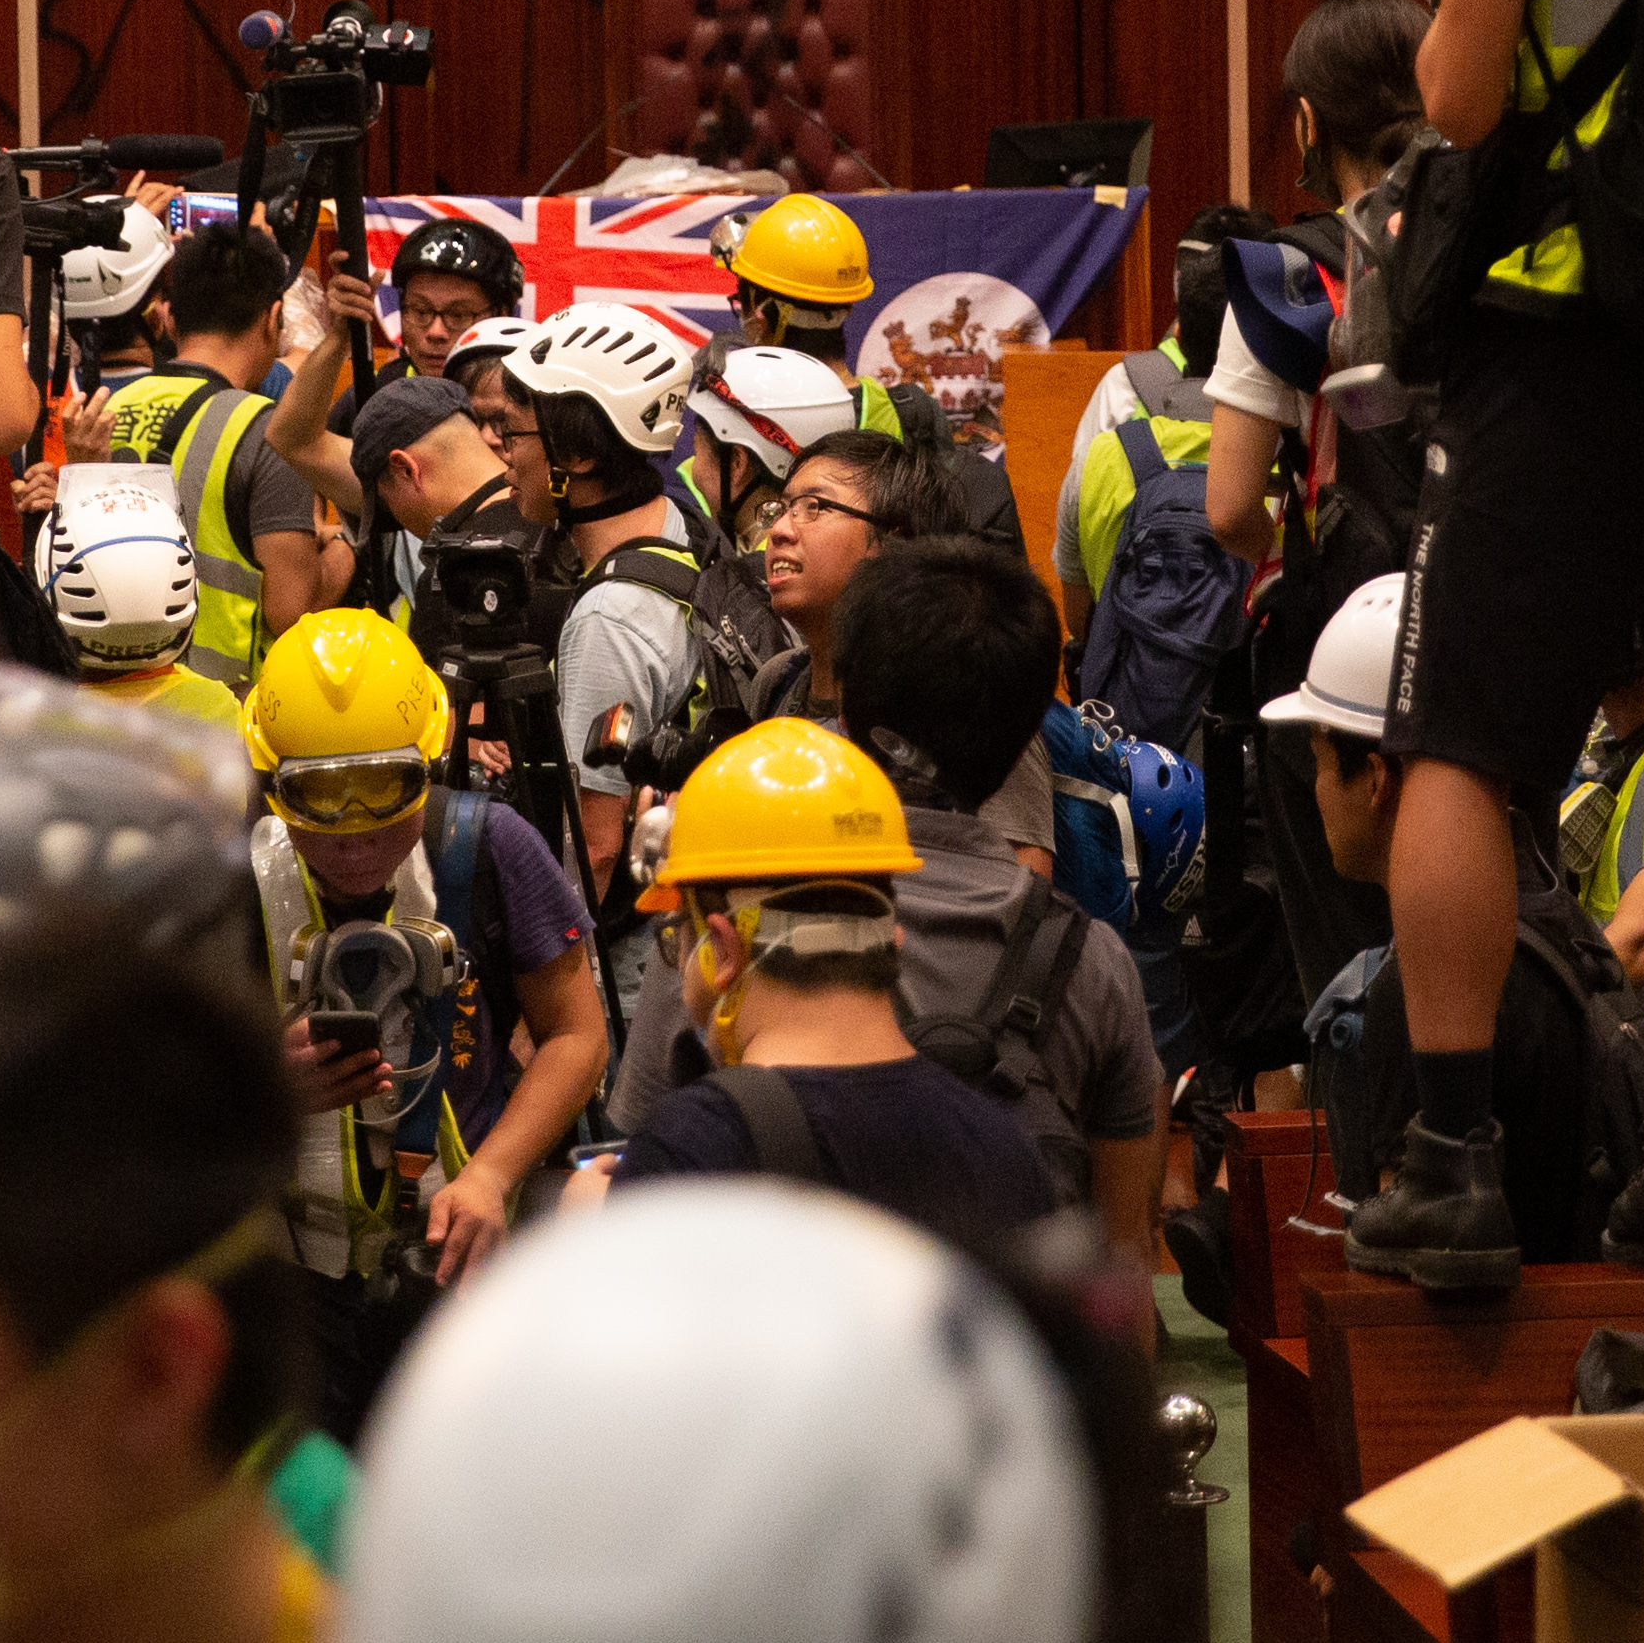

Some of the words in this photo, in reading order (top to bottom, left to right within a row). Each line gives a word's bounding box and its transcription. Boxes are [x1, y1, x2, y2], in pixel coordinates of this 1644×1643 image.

[1414, 523, 1434, 567] THE
[1405, 569, 1424, 649] NORTH
[1396, 652, 1416, 714] FACE
